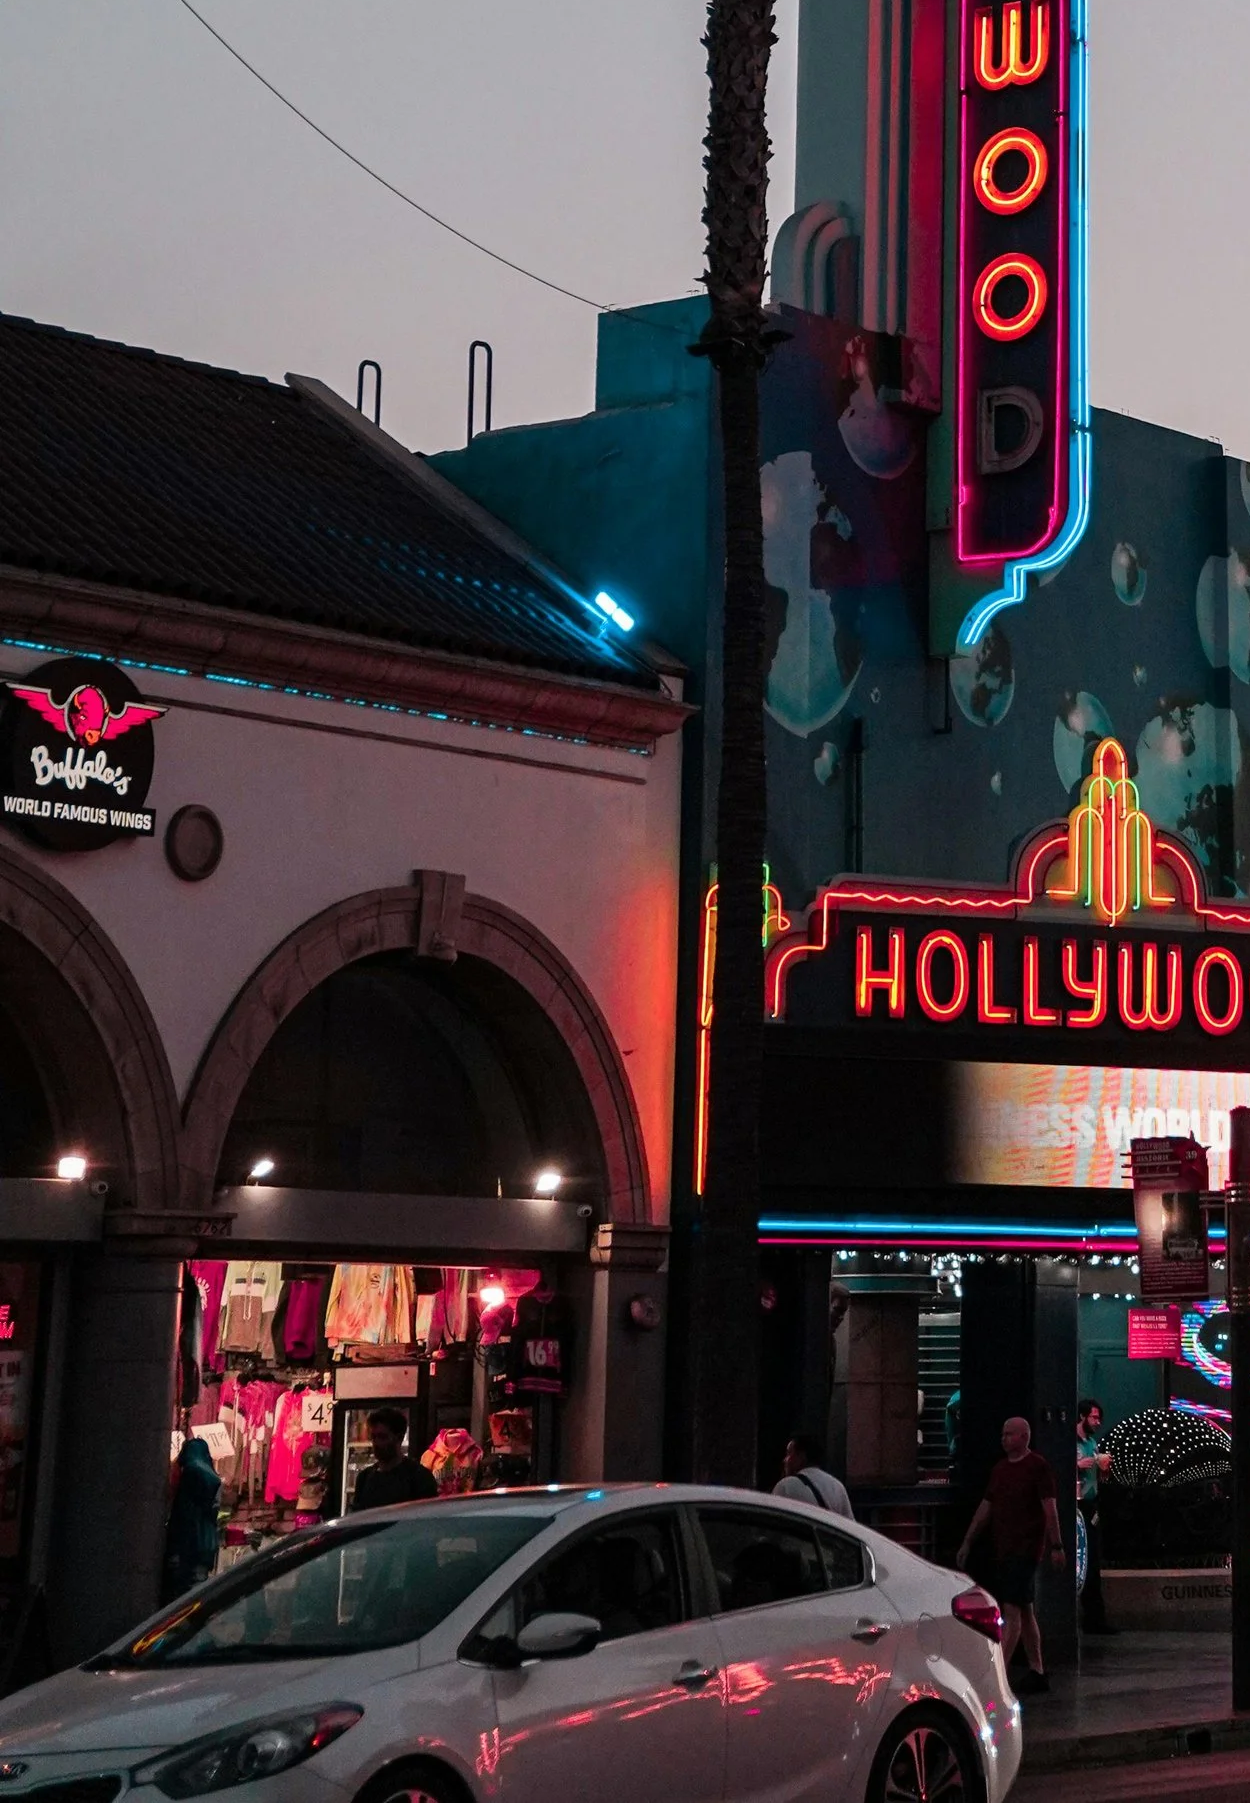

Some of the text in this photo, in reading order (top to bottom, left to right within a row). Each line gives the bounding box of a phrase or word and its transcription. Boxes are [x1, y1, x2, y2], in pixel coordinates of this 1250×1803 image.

[31, 745, 132, 795] Buffalo's
[4, 796, 152, 831] WORLD FAMOUS WINGS
[1103, 1106, 1229, 1154] WORLD
[1161, 1584, 1232, 1600] GUINNES
